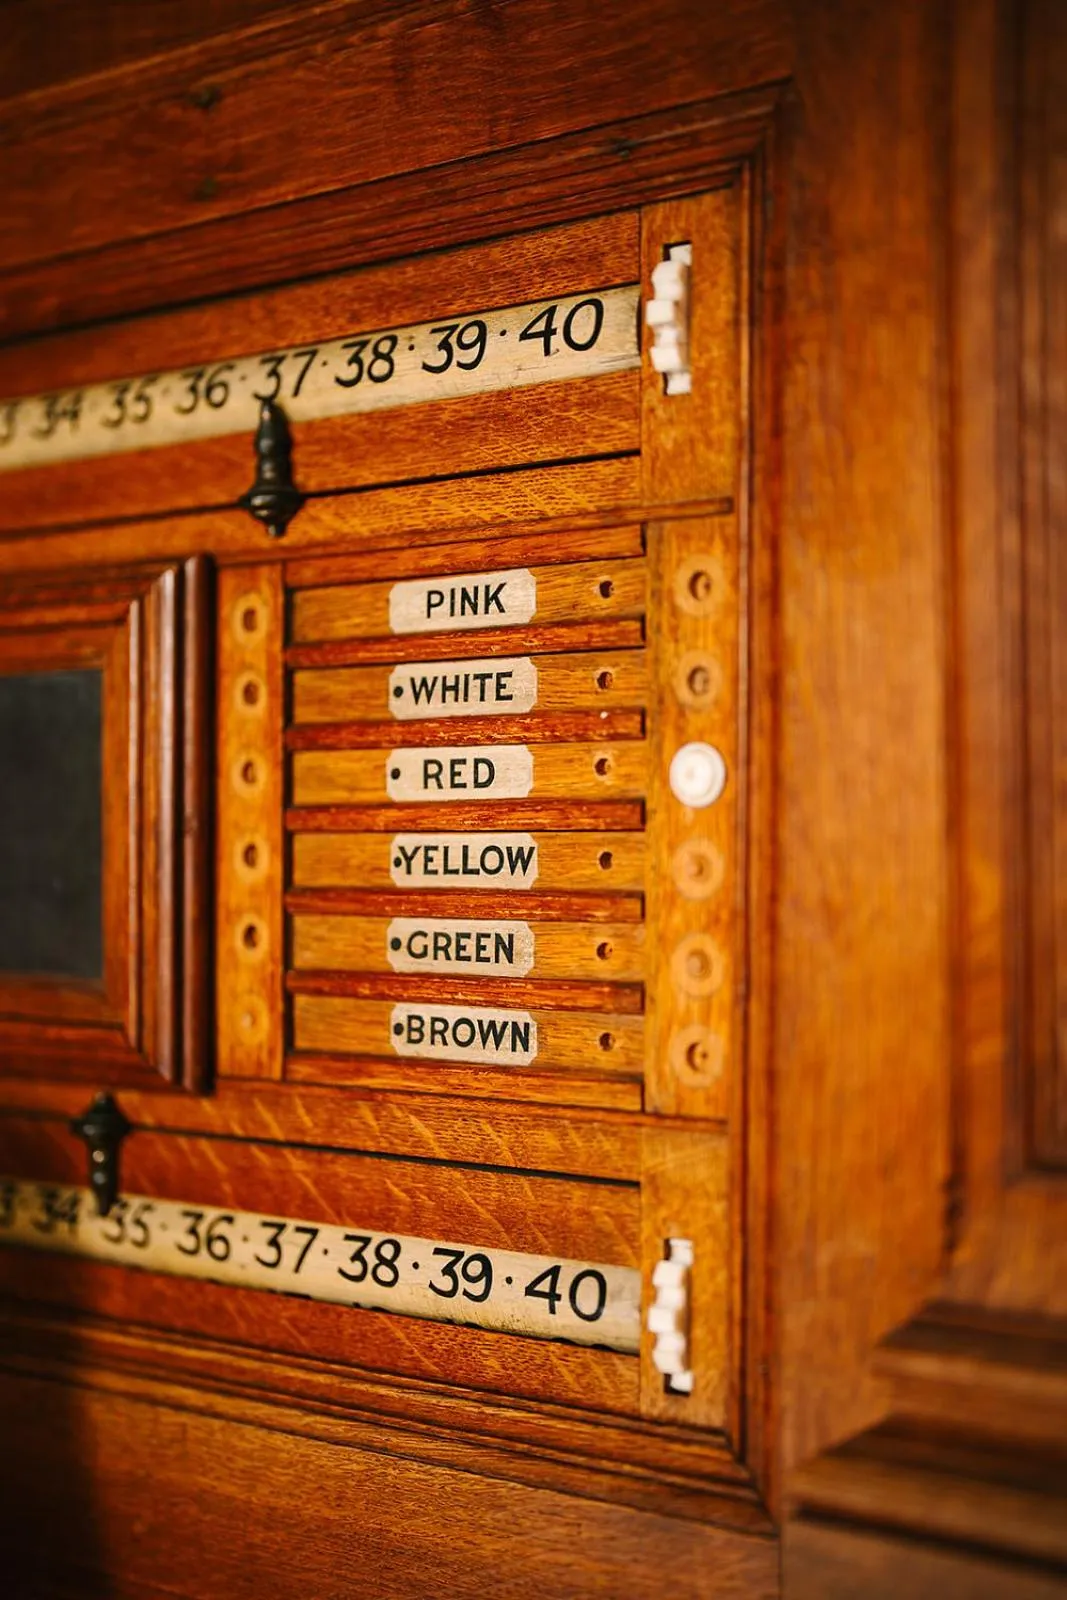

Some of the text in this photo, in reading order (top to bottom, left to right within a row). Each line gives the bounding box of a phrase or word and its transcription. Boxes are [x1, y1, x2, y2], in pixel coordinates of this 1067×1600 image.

[34, 391, 83, 440] 34
[101, 375, 156, 428] 35
[173, 364, 233, 415] 36
[252, 348, 318, 403] 37
[335, 334, 398, 388] 38
[422, 319, 487, 374] 39
[519, 298, 604, 357] 40
[427, 582, 507, 619] PINK
[410, 671, 514, 705] WHITE
[423, 758, 495, 790] RED
[399, 845, 535, 877] YELLOW
[406, 930, 514, 964] GREEN
[406, 1014, 530, 1052] BROWN
[101, 1199, 155, 1249] 35
[174, 1209, 233, 1262] 36
[255, 1221, 319, 1274] 37
[338, 1234, 401, 1287] 38
[428, 1247, 493, 1302] 39
[524, 1265, 607, 1322] 40
